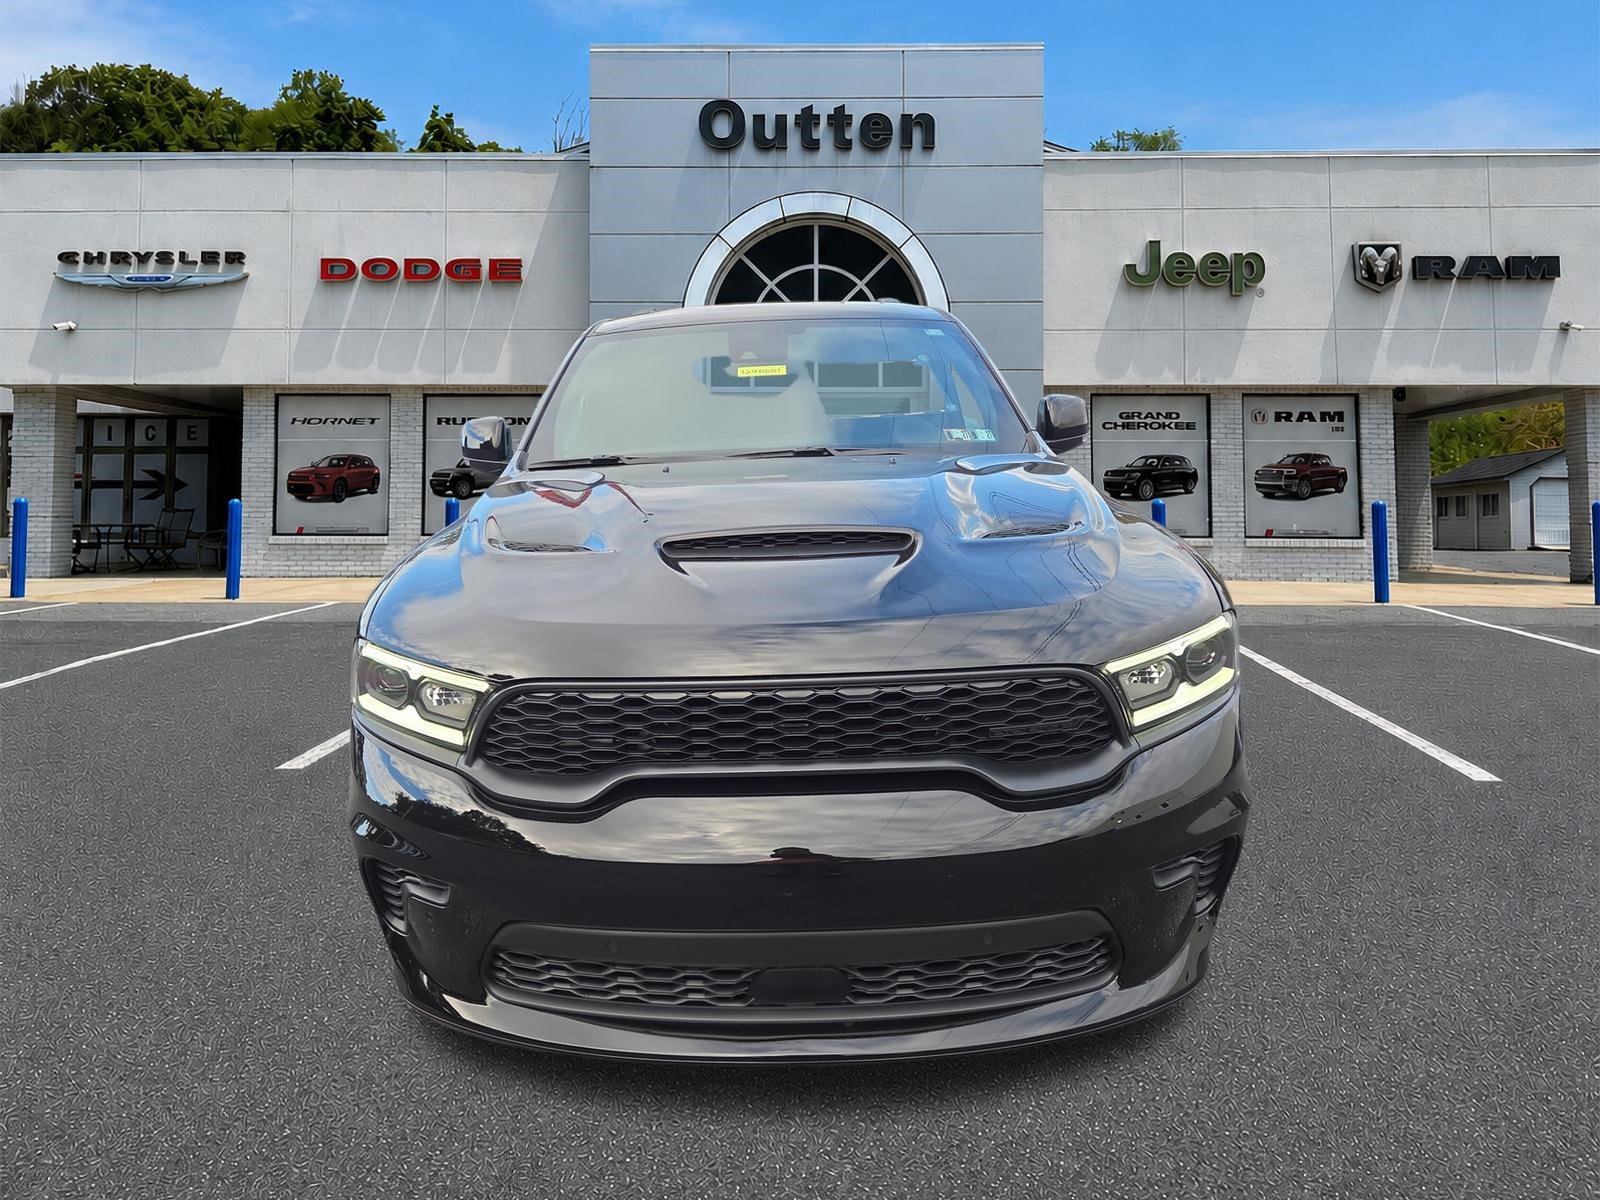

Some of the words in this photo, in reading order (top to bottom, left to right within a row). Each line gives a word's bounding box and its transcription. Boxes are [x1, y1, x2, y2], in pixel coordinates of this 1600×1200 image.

[699, 98, 936, 150] Outten
[57, 250, 246, 266] CHRYSLER
[320, 256, 523, 283] DODGE
[1123, 239, 1266, 297] Jeep
[1411, 255, 1561, 280] RAM
[290, 417, 381, 426] HORNET
[1118, 411, 1180, 420] GRAND
[1274, 411, 1345, 423] RAM
[1101, 421, 1197, 431] CHEROKEE
